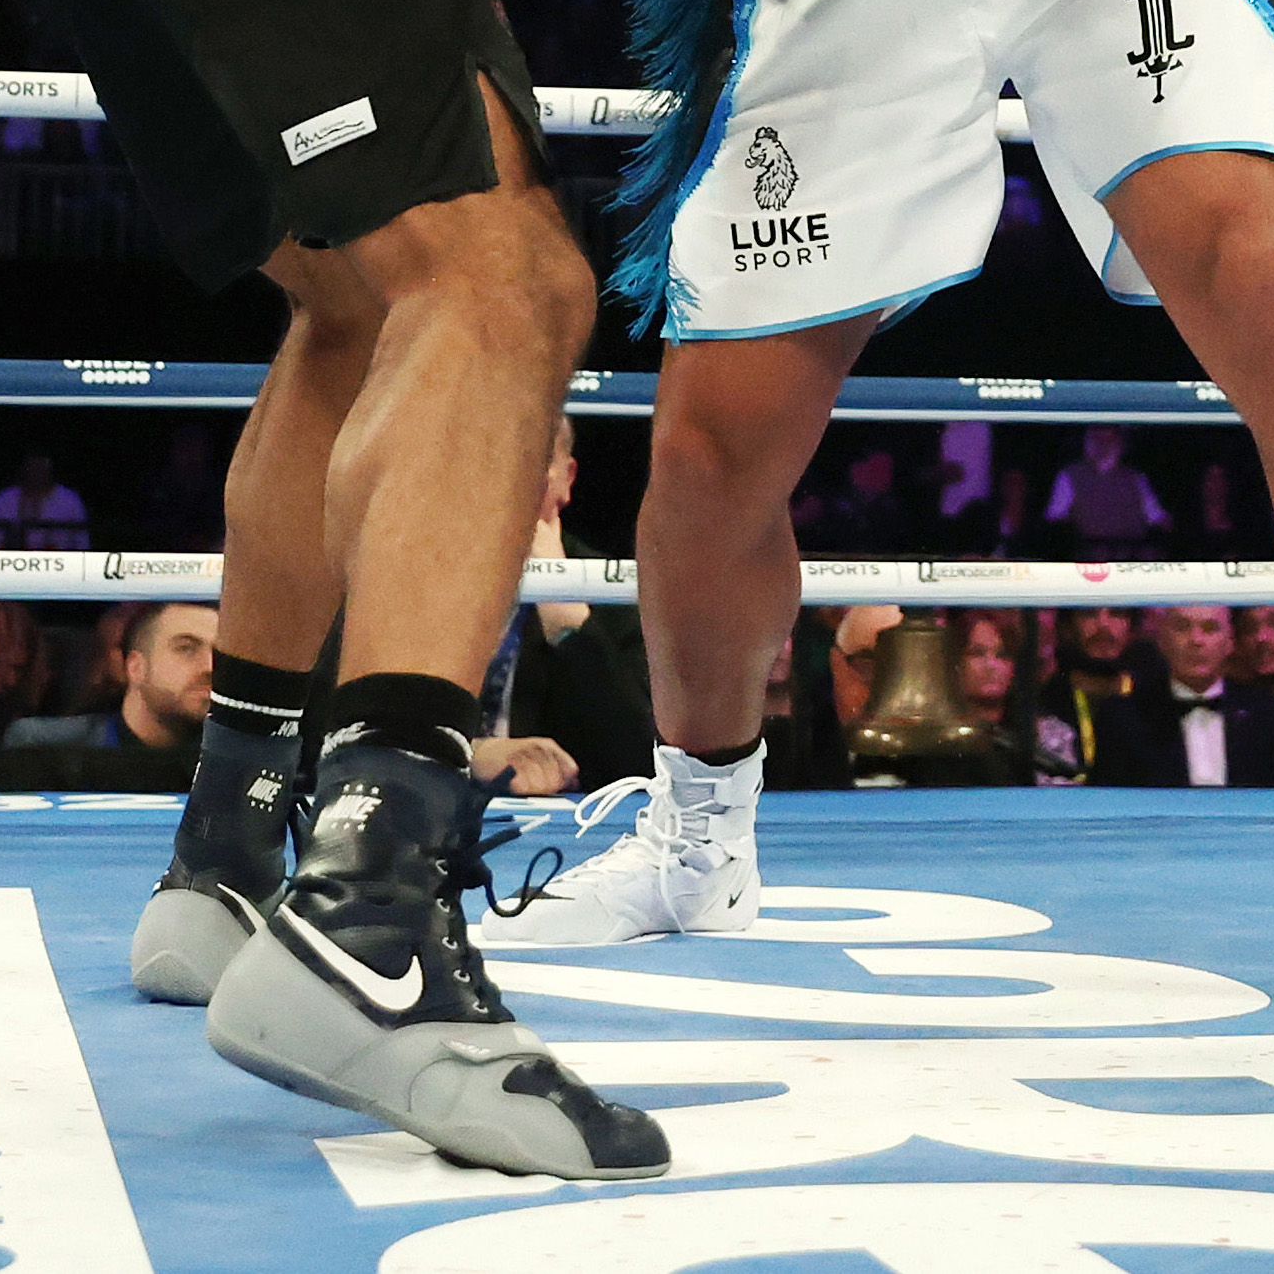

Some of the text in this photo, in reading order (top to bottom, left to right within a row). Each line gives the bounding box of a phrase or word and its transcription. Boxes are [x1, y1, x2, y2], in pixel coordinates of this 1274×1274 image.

[730, 213, 830, 250] LUKE
[735, 243, 831, 272] SPORT
[247, 776, 282, 804] NIKE
